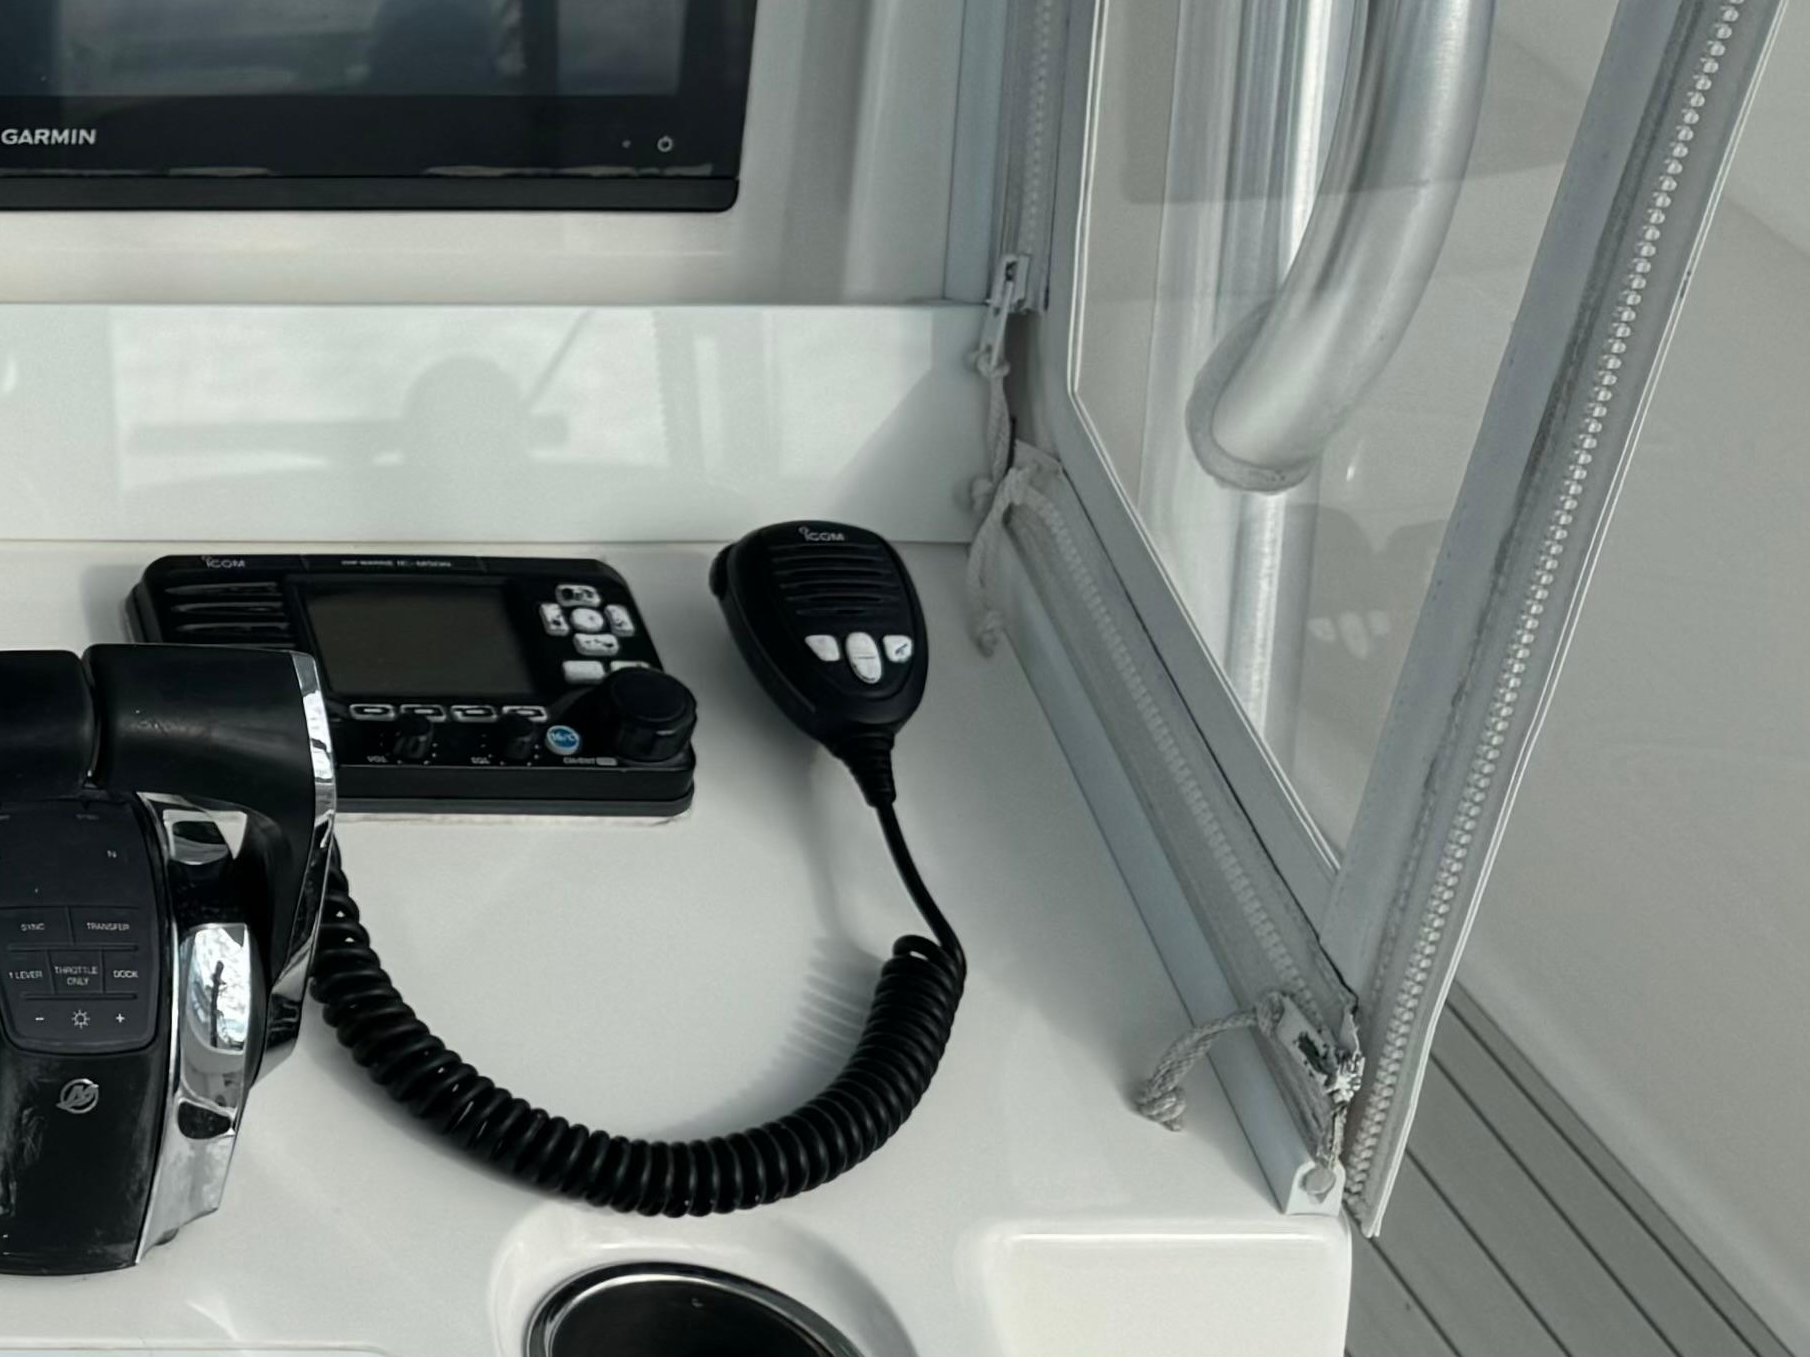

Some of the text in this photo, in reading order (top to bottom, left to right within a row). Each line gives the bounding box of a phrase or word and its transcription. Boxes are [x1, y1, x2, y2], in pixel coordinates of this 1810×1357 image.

[0, 129, 97, 146] GARMIN
[20, 922, 45, 932] SYNC
[86, 922, 130, 932] TRANSFER
[54, 966, 98, 976] THROTTLE
